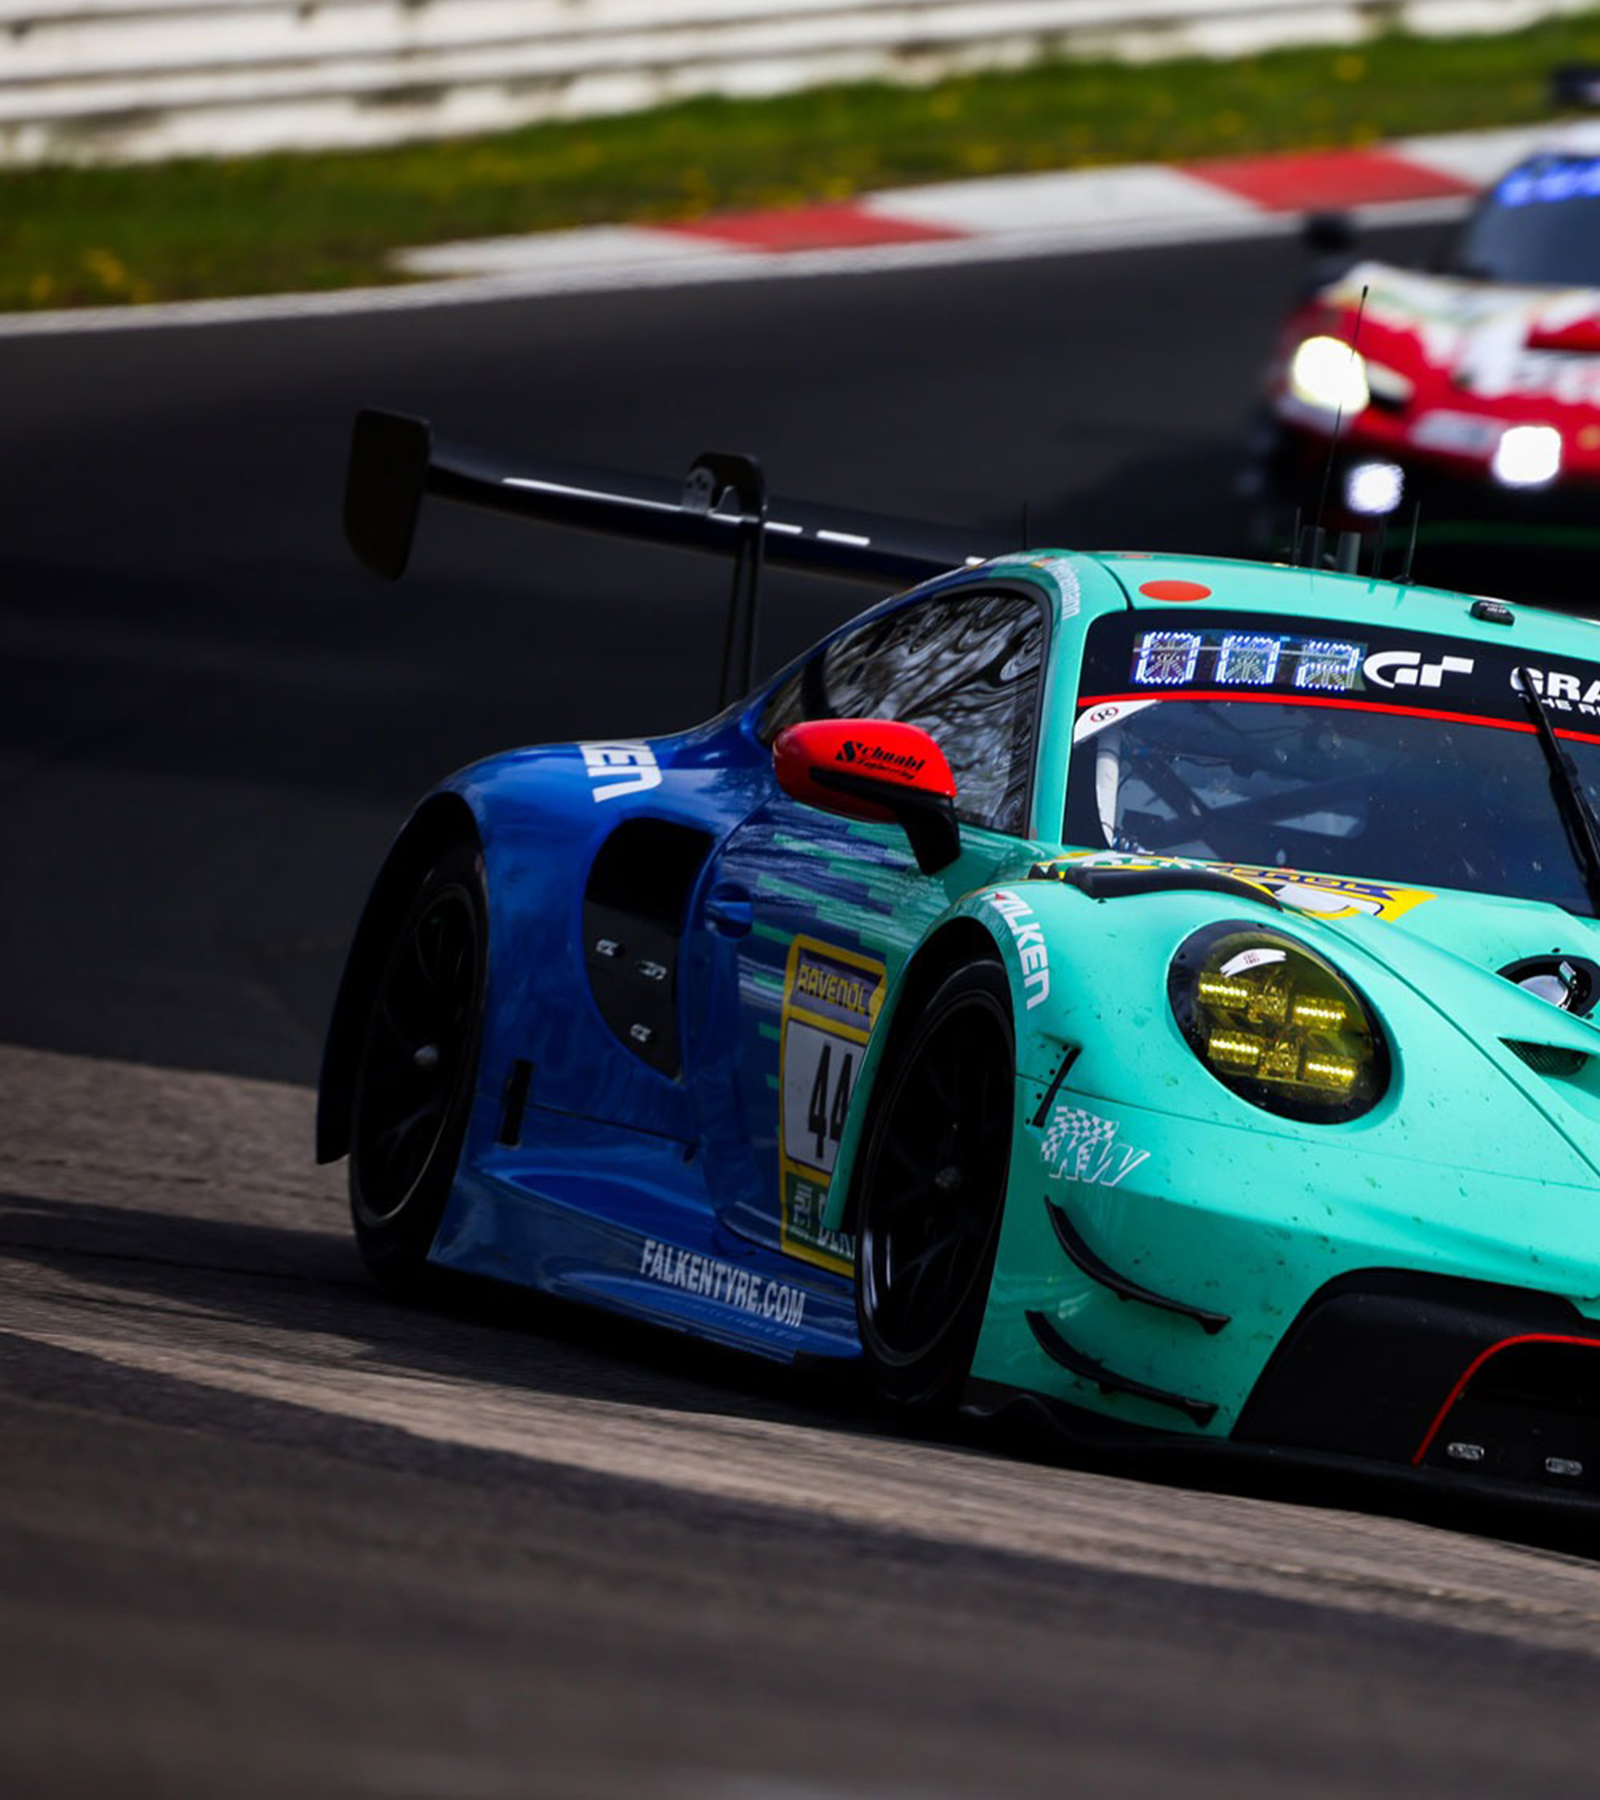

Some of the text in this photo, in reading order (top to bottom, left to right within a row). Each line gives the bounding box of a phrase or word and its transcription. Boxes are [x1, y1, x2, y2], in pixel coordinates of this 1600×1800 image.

[1362, 650, 1475, 688] GT
[981, 890, 1050, 1010] FALKEN
[797, 965, 868, 1014] RAVENOL
[1049, 1132, 1151, 1186] KW
[640, 1239, 806, 1328] FALKENTYRE.COM
